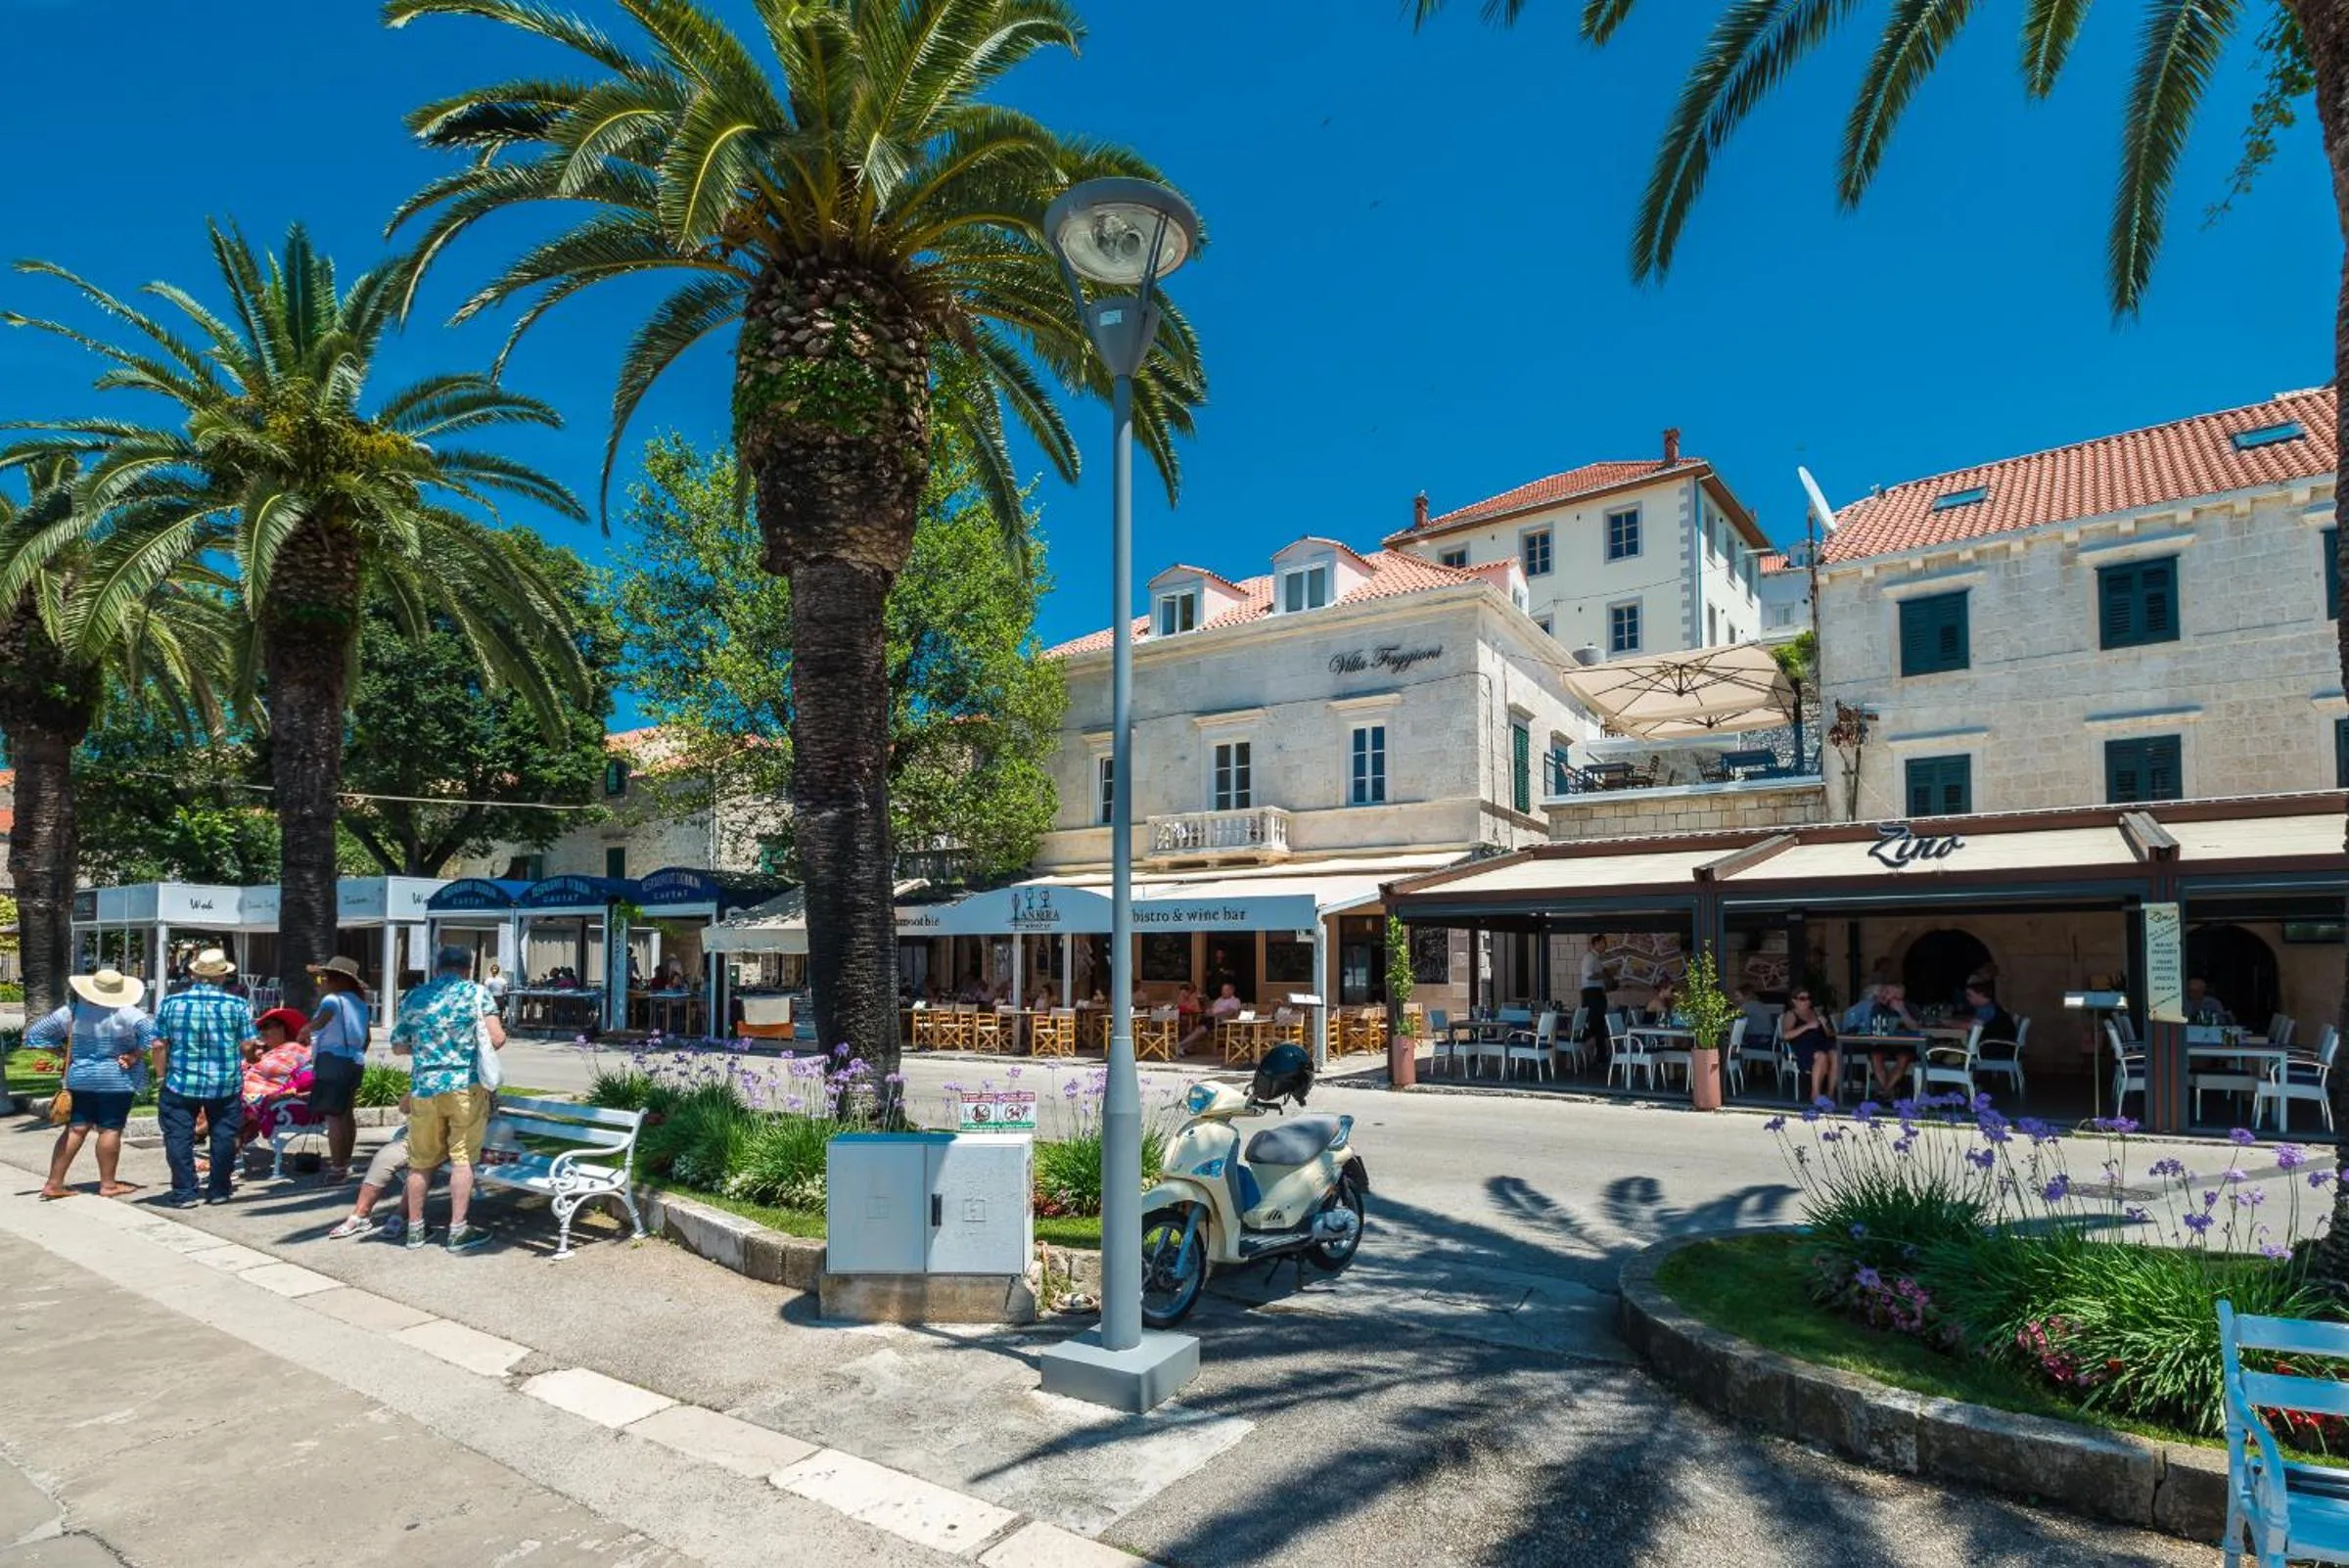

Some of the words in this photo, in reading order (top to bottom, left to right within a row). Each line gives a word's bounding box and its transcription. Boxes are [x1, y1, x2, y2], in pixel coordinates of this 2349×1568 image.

[1329, 649, 1366, 675] Villa
[1867, 822, 1965, 868] Zino
[1131, 908, 1170, 922] bistro
[1173, 907, 1183, 922] &
[1185, 907, 1220, 921] wine
[1222, 906, 1246, 920] bar
